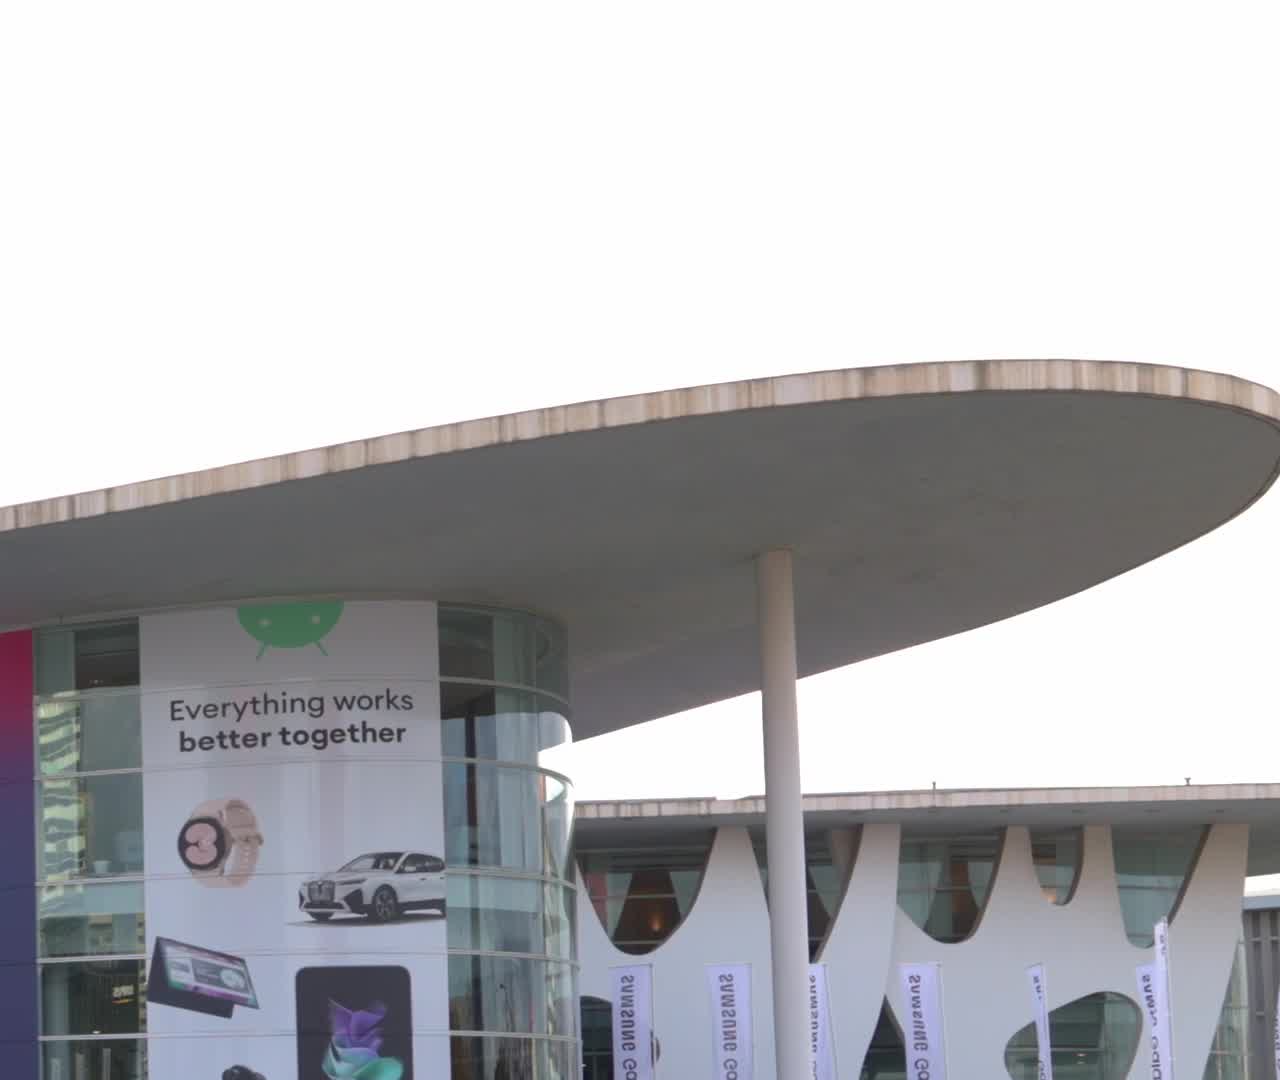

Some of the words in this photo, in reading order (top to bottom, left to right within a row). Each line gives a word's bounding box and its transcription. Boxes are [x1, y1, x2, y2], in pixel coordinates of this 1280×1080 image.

[169, 691, 325, 722] Everything
[332, 688, 414, 712] works
[179, 730, 272, 753] better
[278, 720, 407, 750] together
